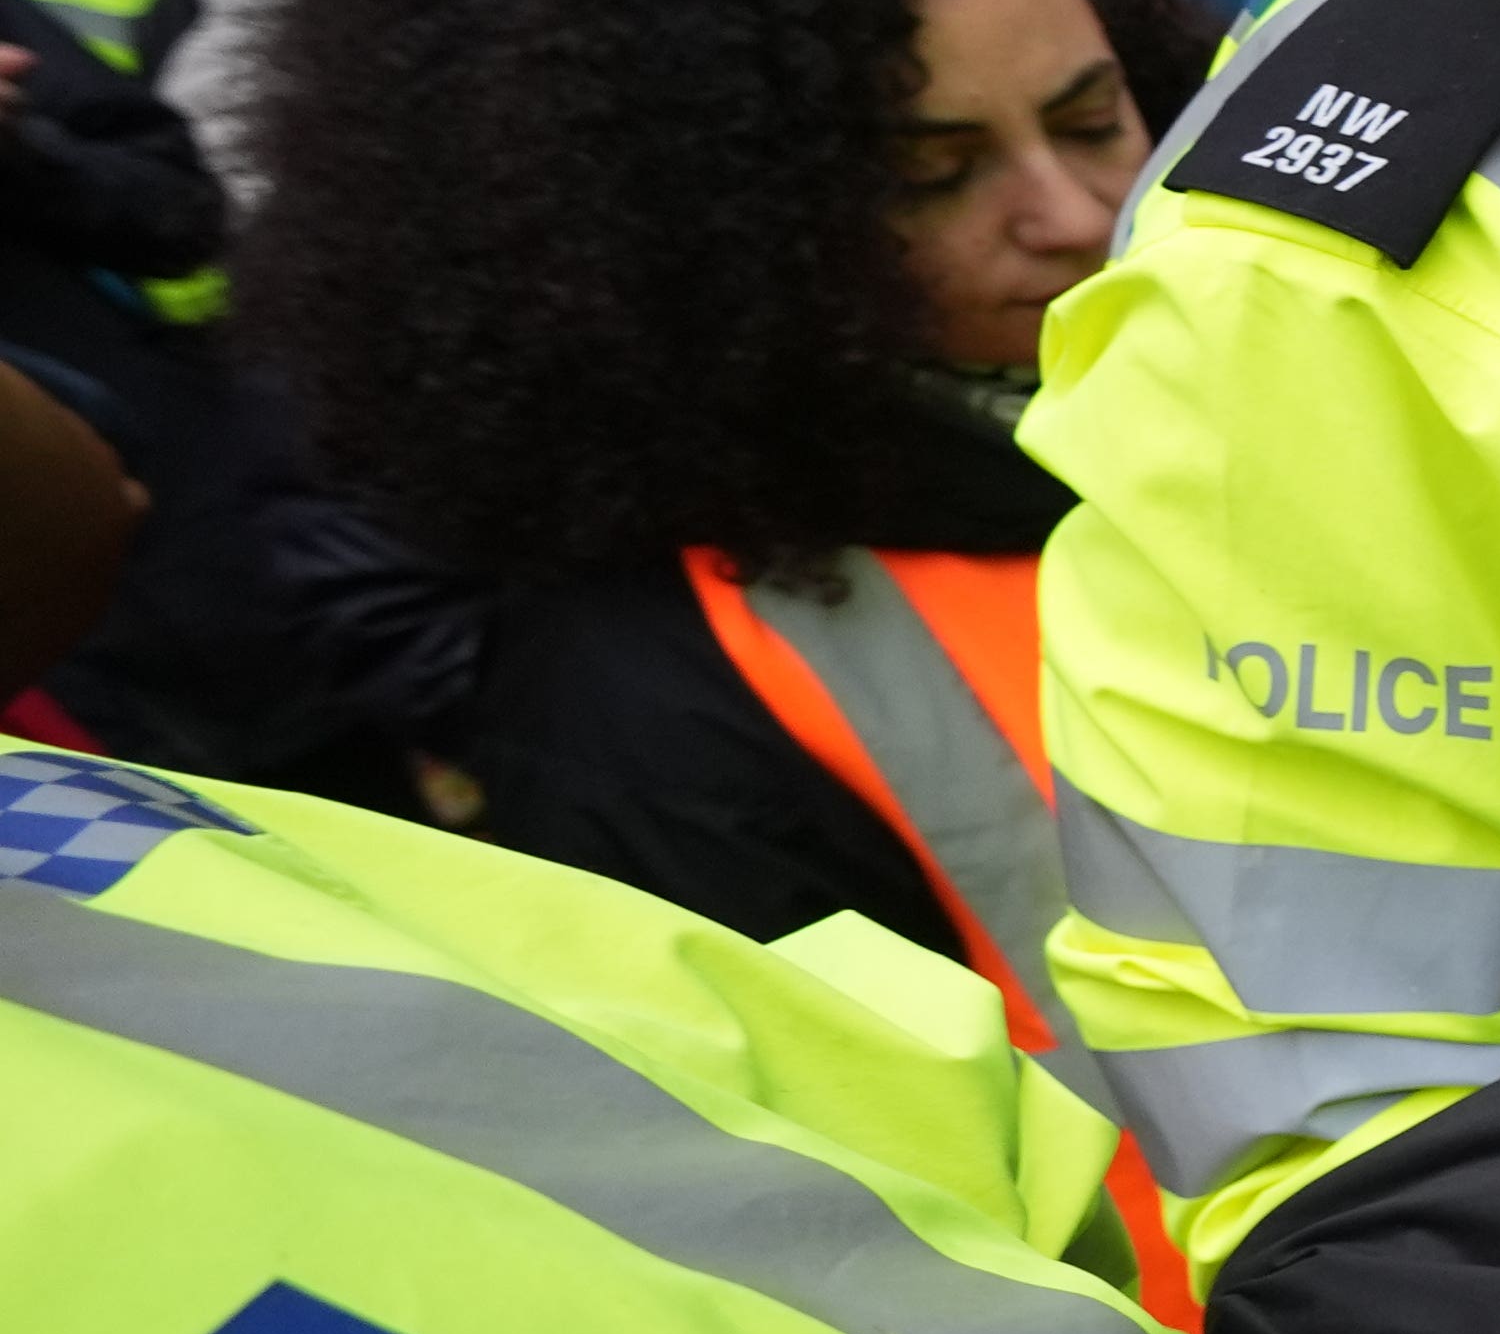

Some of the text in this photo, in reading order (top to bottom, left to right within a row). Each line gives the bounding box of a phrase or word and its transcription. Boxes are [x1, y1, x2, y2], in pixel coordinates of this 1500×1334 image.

[1294, 82, 1410, 145] NW
[1240, 125, 1390, 193] 2937
[1204, 640, 1495, 741] OLICE
